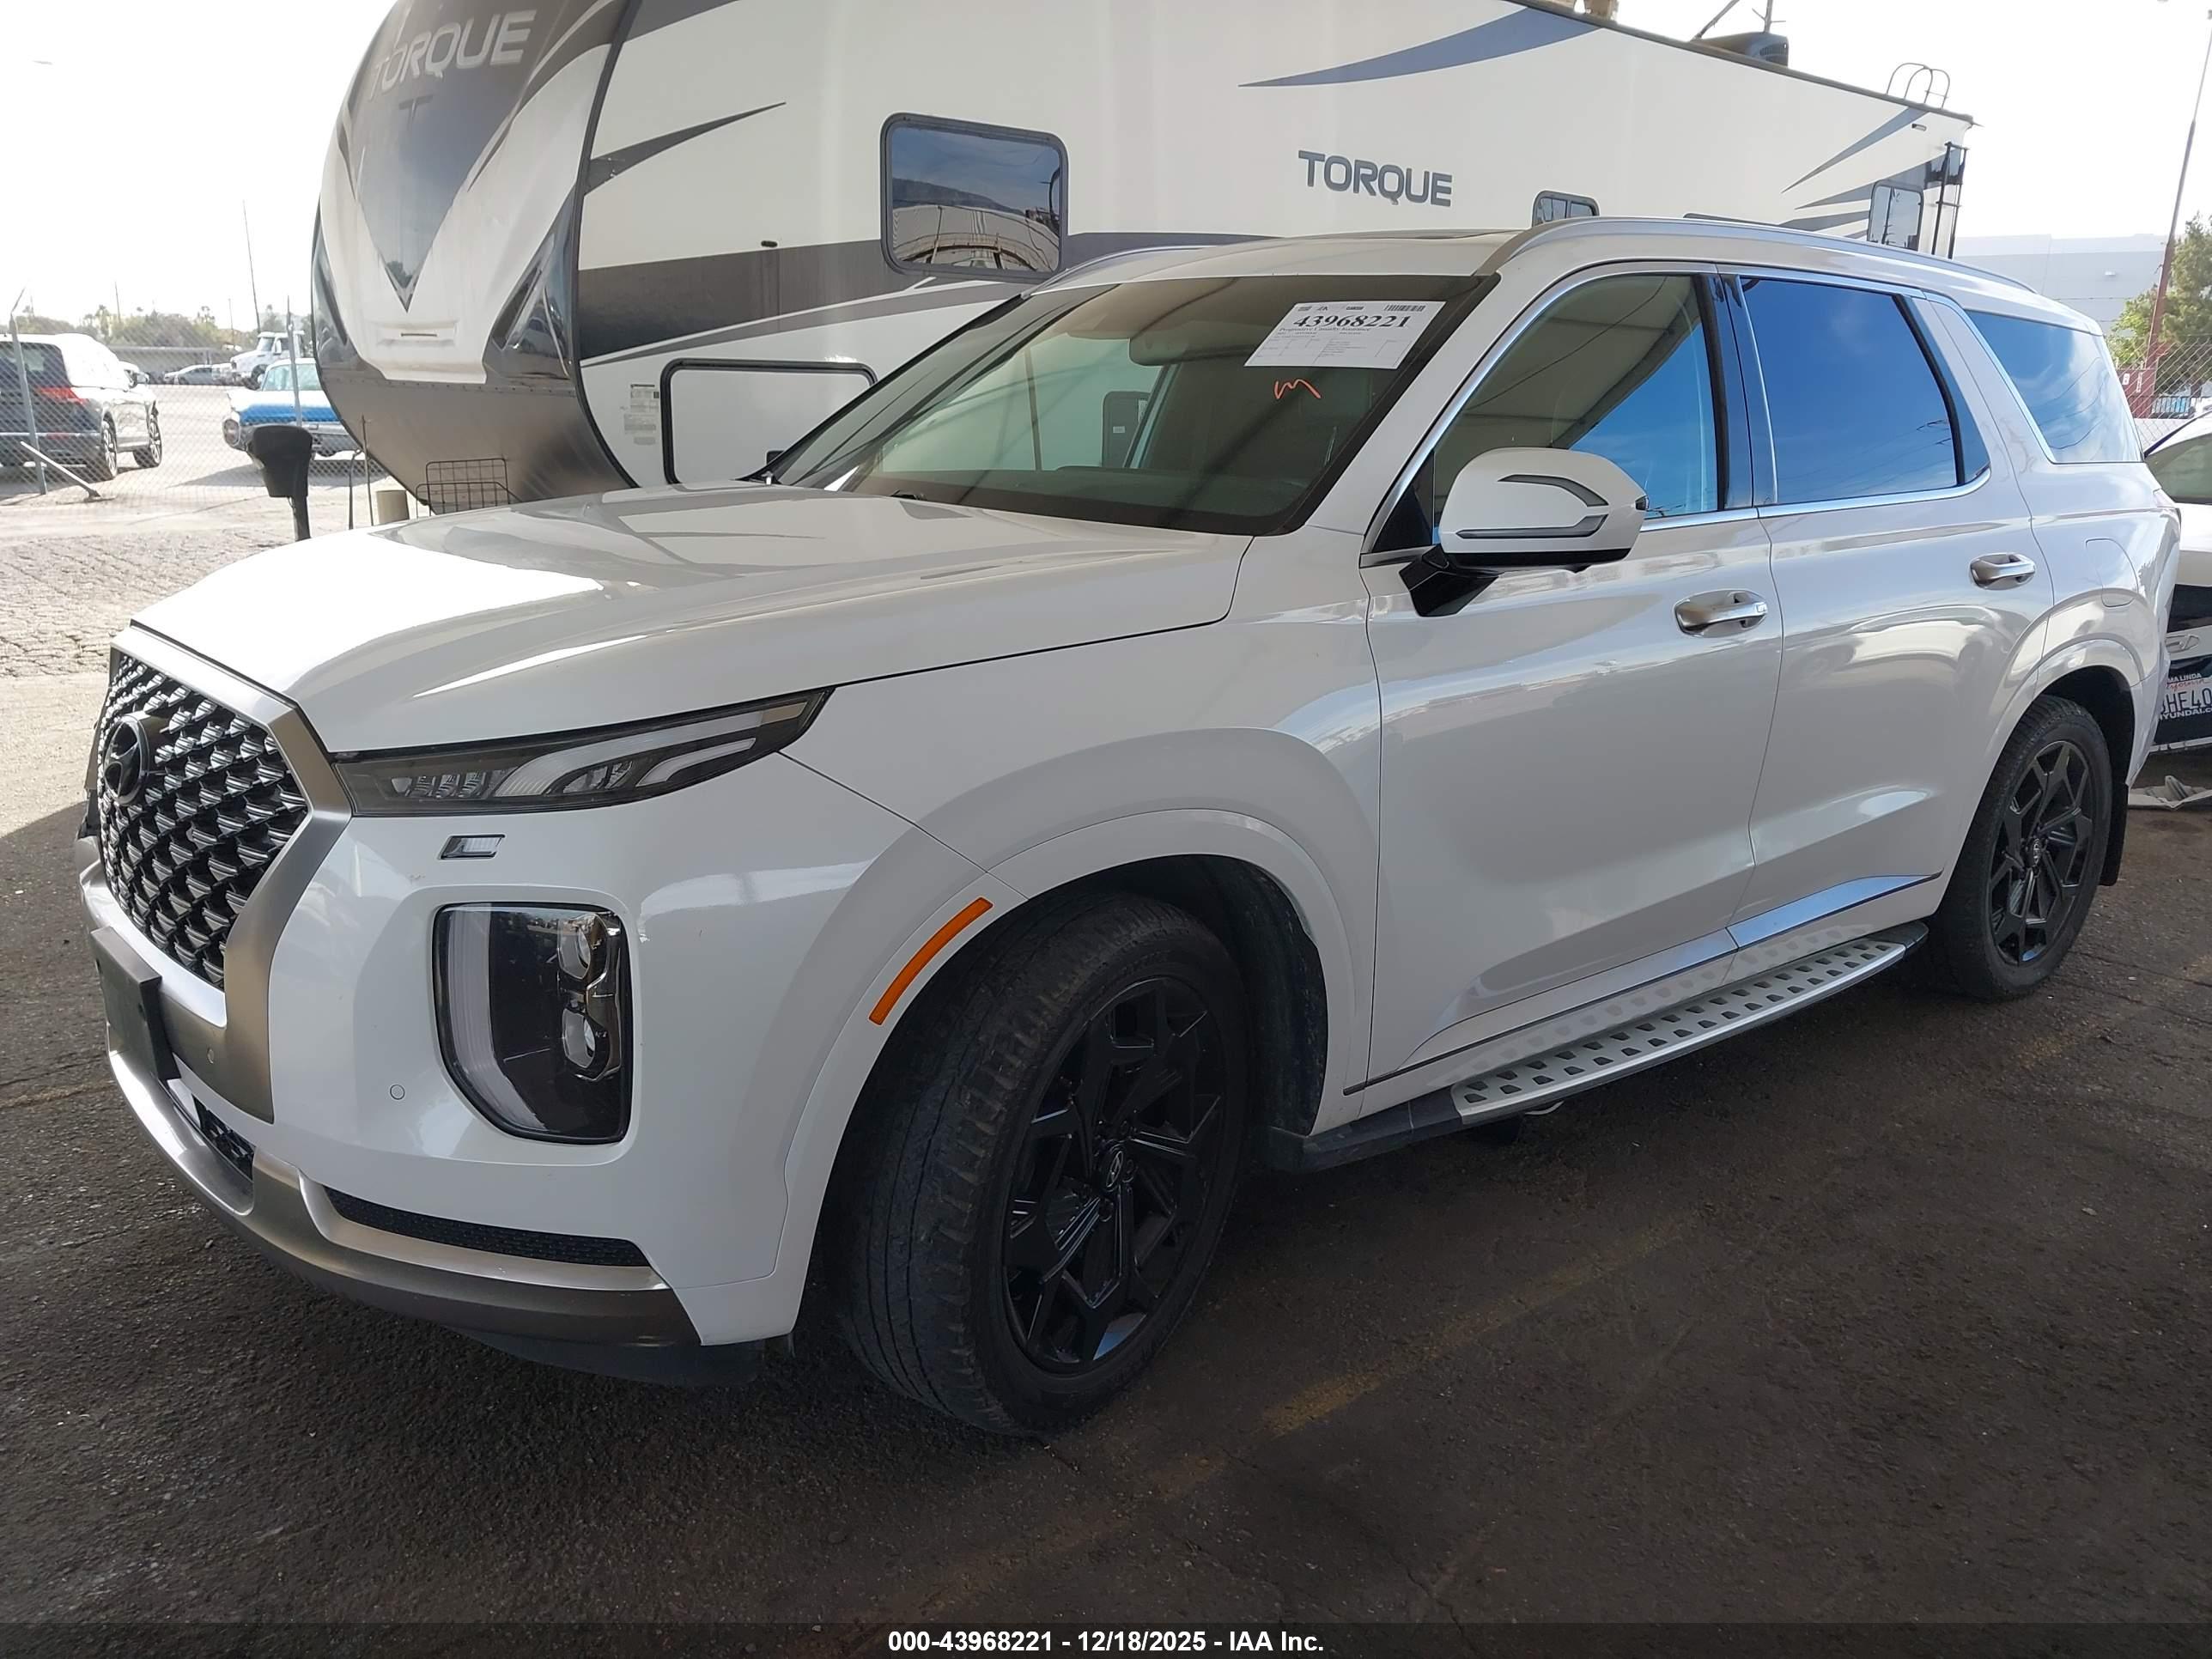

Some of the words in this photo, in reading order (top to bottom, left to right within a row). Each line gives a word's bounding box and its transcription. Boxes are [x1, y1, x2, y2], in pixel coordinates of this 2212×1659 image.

[369, 9, 537, 101] TORQUE
[1298, 149, 1452, 207] TORQUE
[1293, 314, 1412, 328] 43968221
[2179, 672, 2202, 681] LINDA
